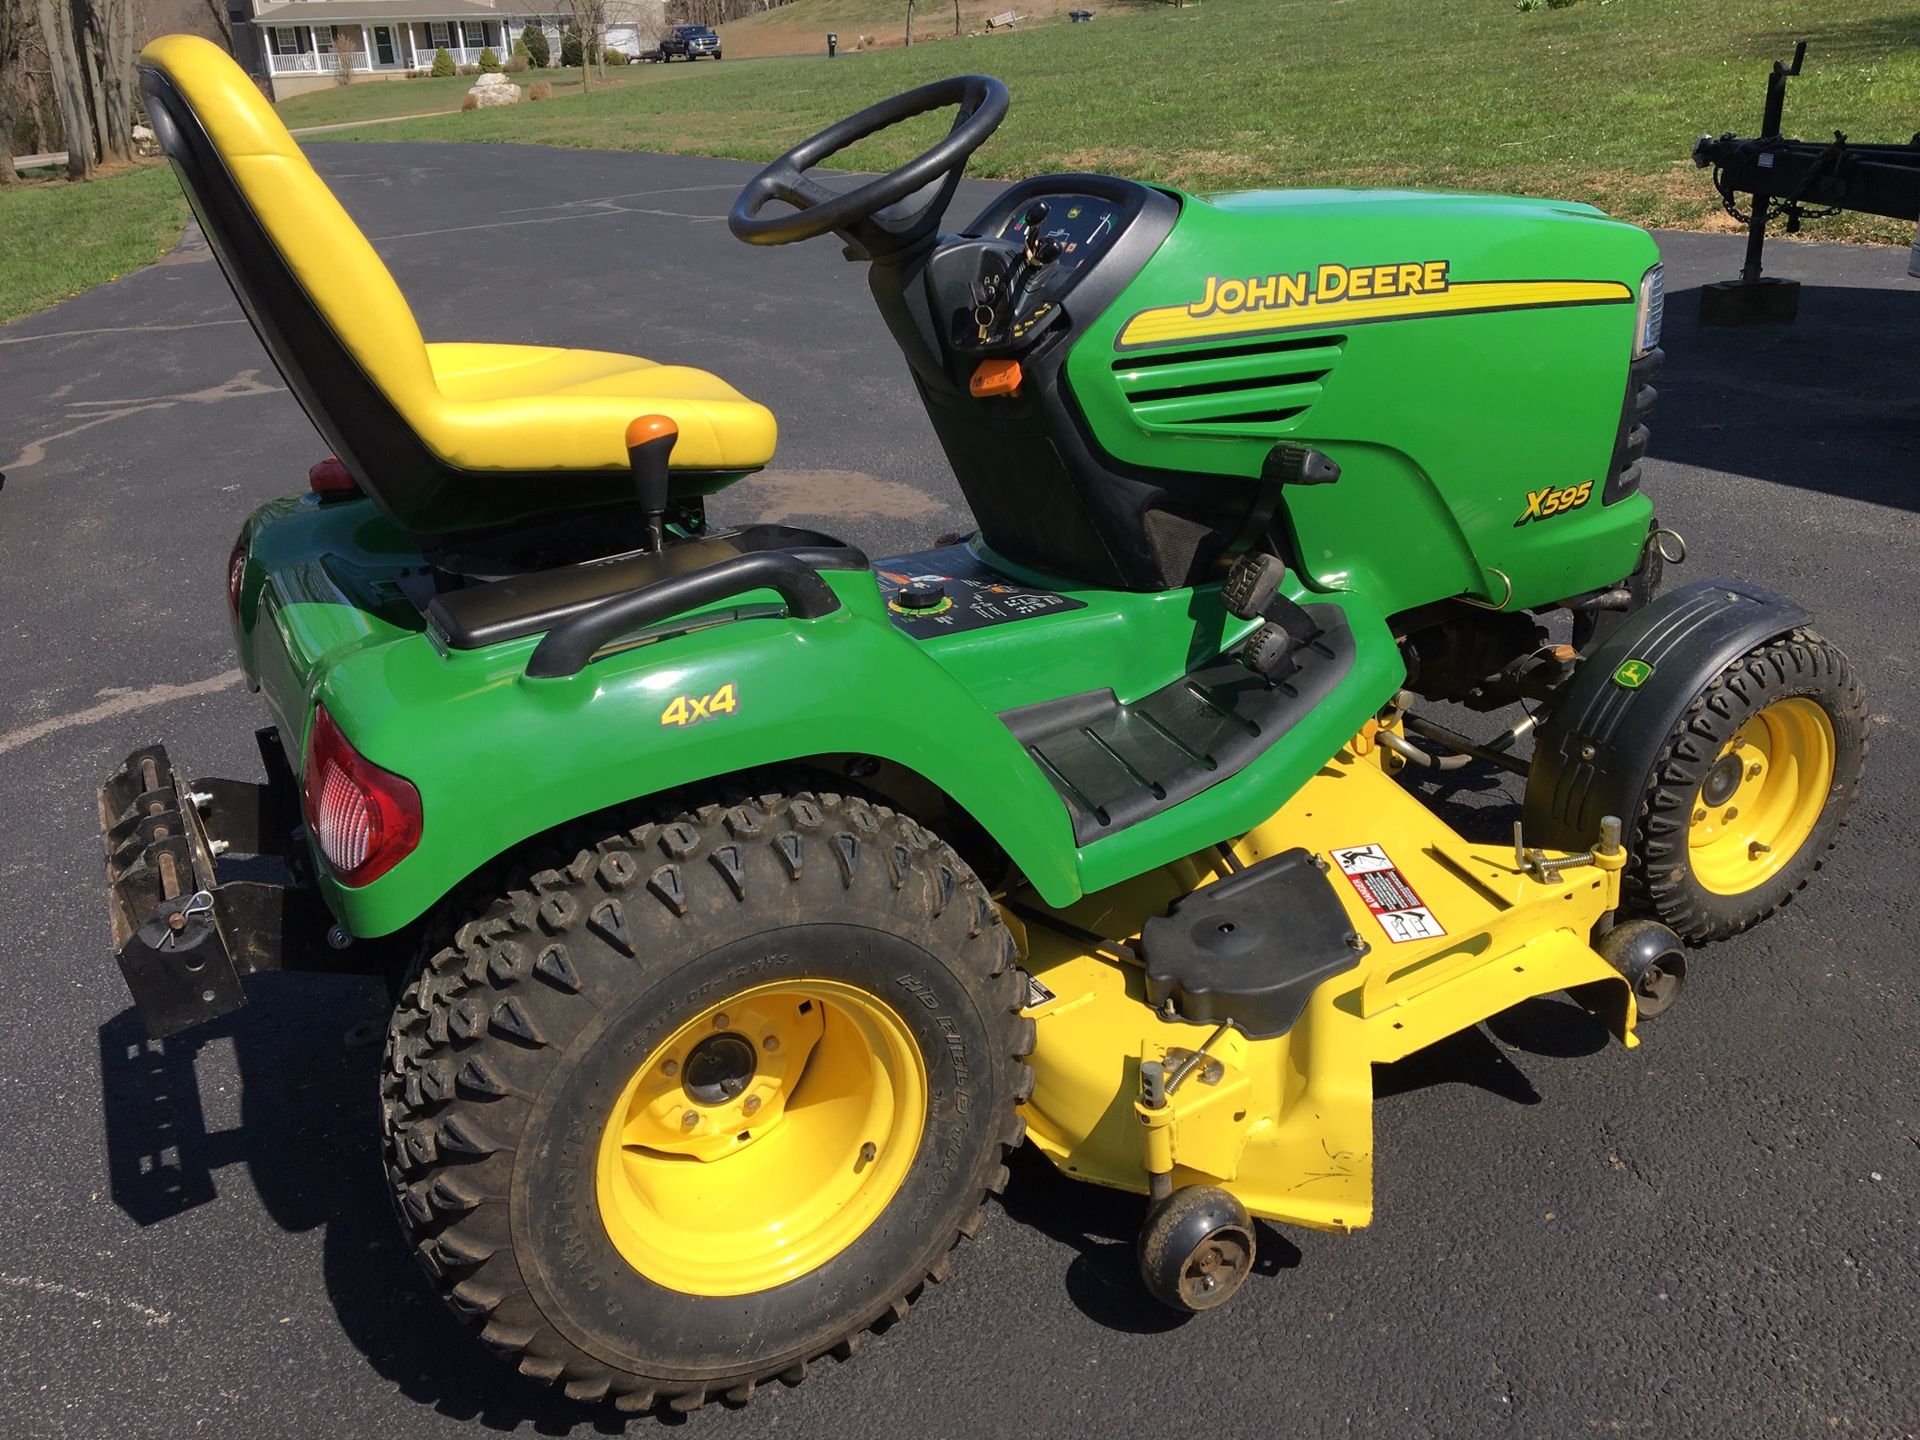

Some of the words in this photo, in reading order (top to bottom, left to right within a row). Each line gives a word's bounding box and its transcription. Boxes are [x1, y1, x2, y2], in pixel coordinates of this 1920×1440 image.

[1188, 274, 1307, 317] JOHN
[1315, 260, 1449, 302] DEERE
[1514, 480, 1594, 527] X595
